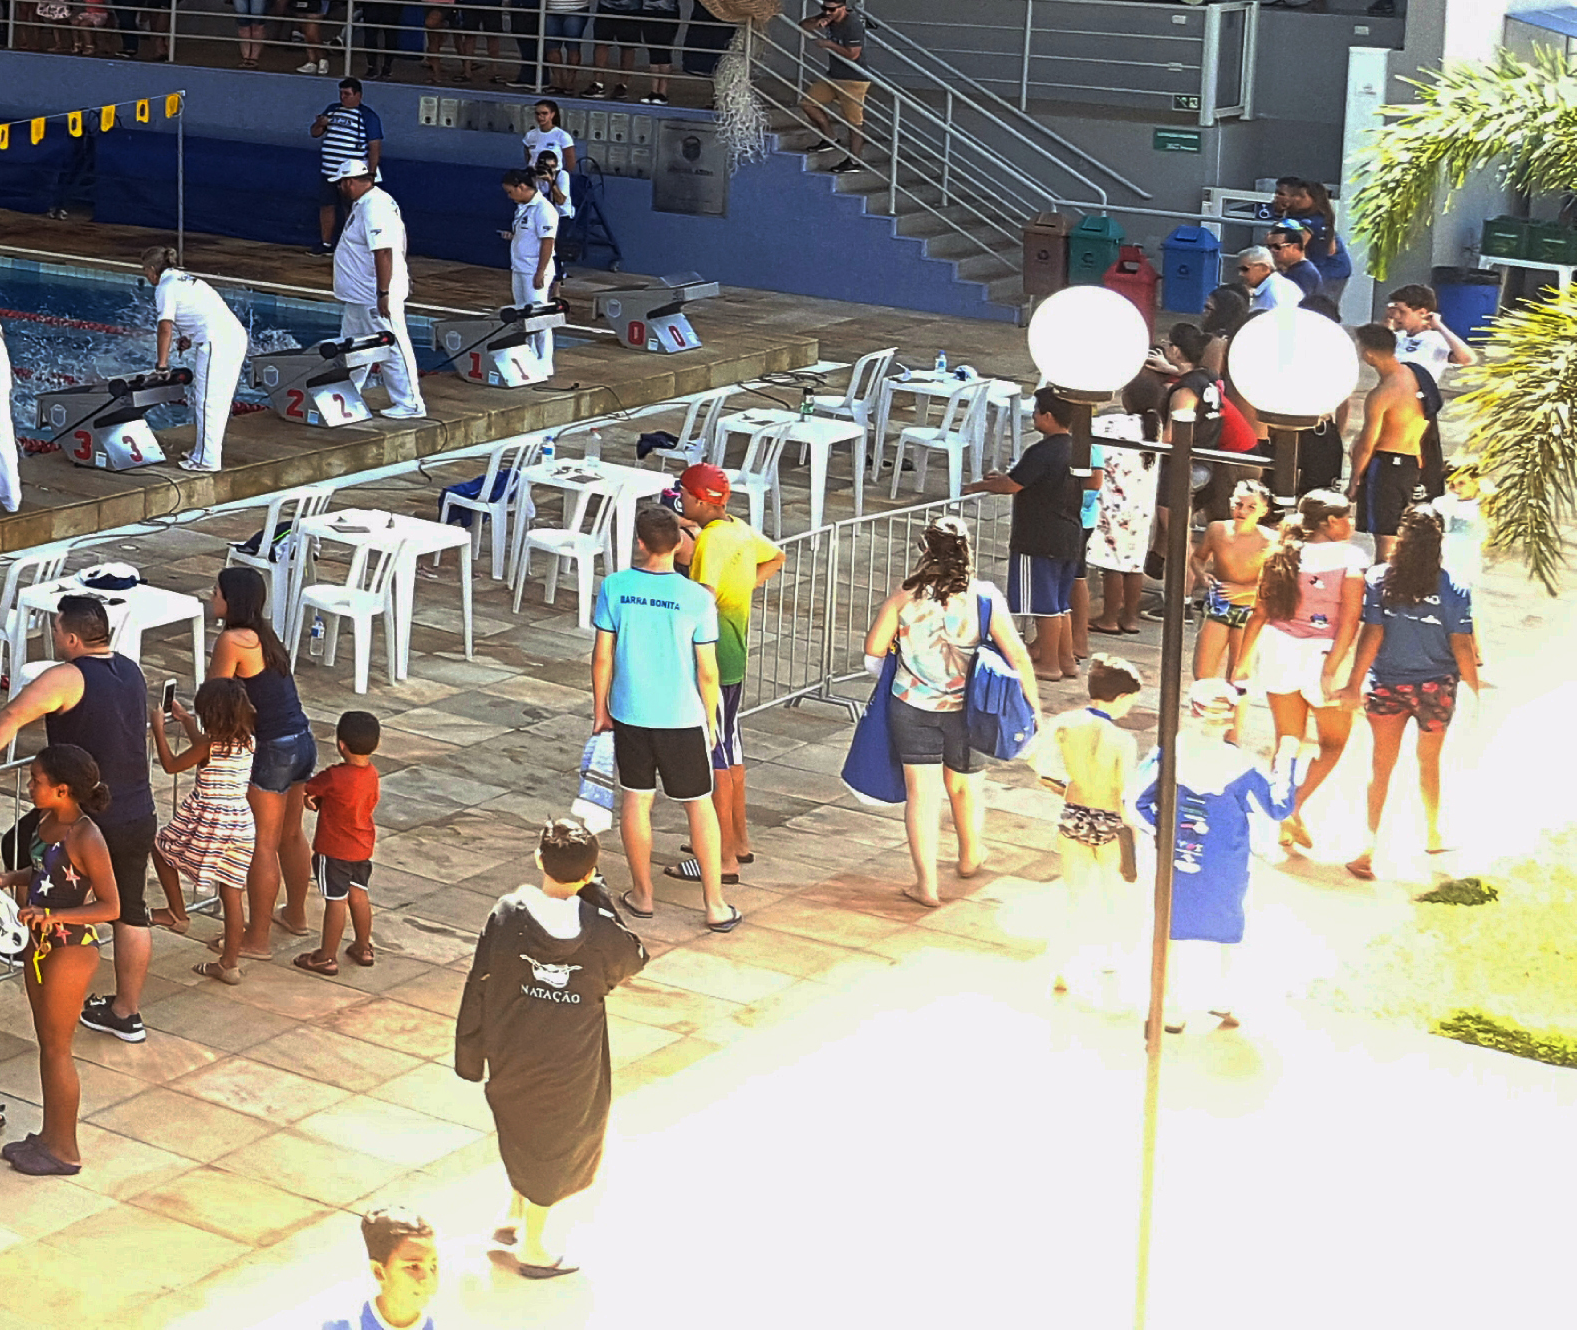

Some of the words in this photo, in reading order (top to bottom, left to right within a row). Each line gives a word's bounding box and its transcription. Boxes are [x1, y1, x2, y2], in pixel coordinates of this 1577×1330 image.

[468, 351, 483, 379] 1
[286, 388, 305, 418] 2
[332, 393, 353, 418] 2
[74, 430, 93, 461] 3
[122, 435, 144, 462] 3
[620, 595, 647, 605] BARRA
[650, 598, 680, 611] BONITA
[520, 983, 581, 1004] NATAÇÃO
